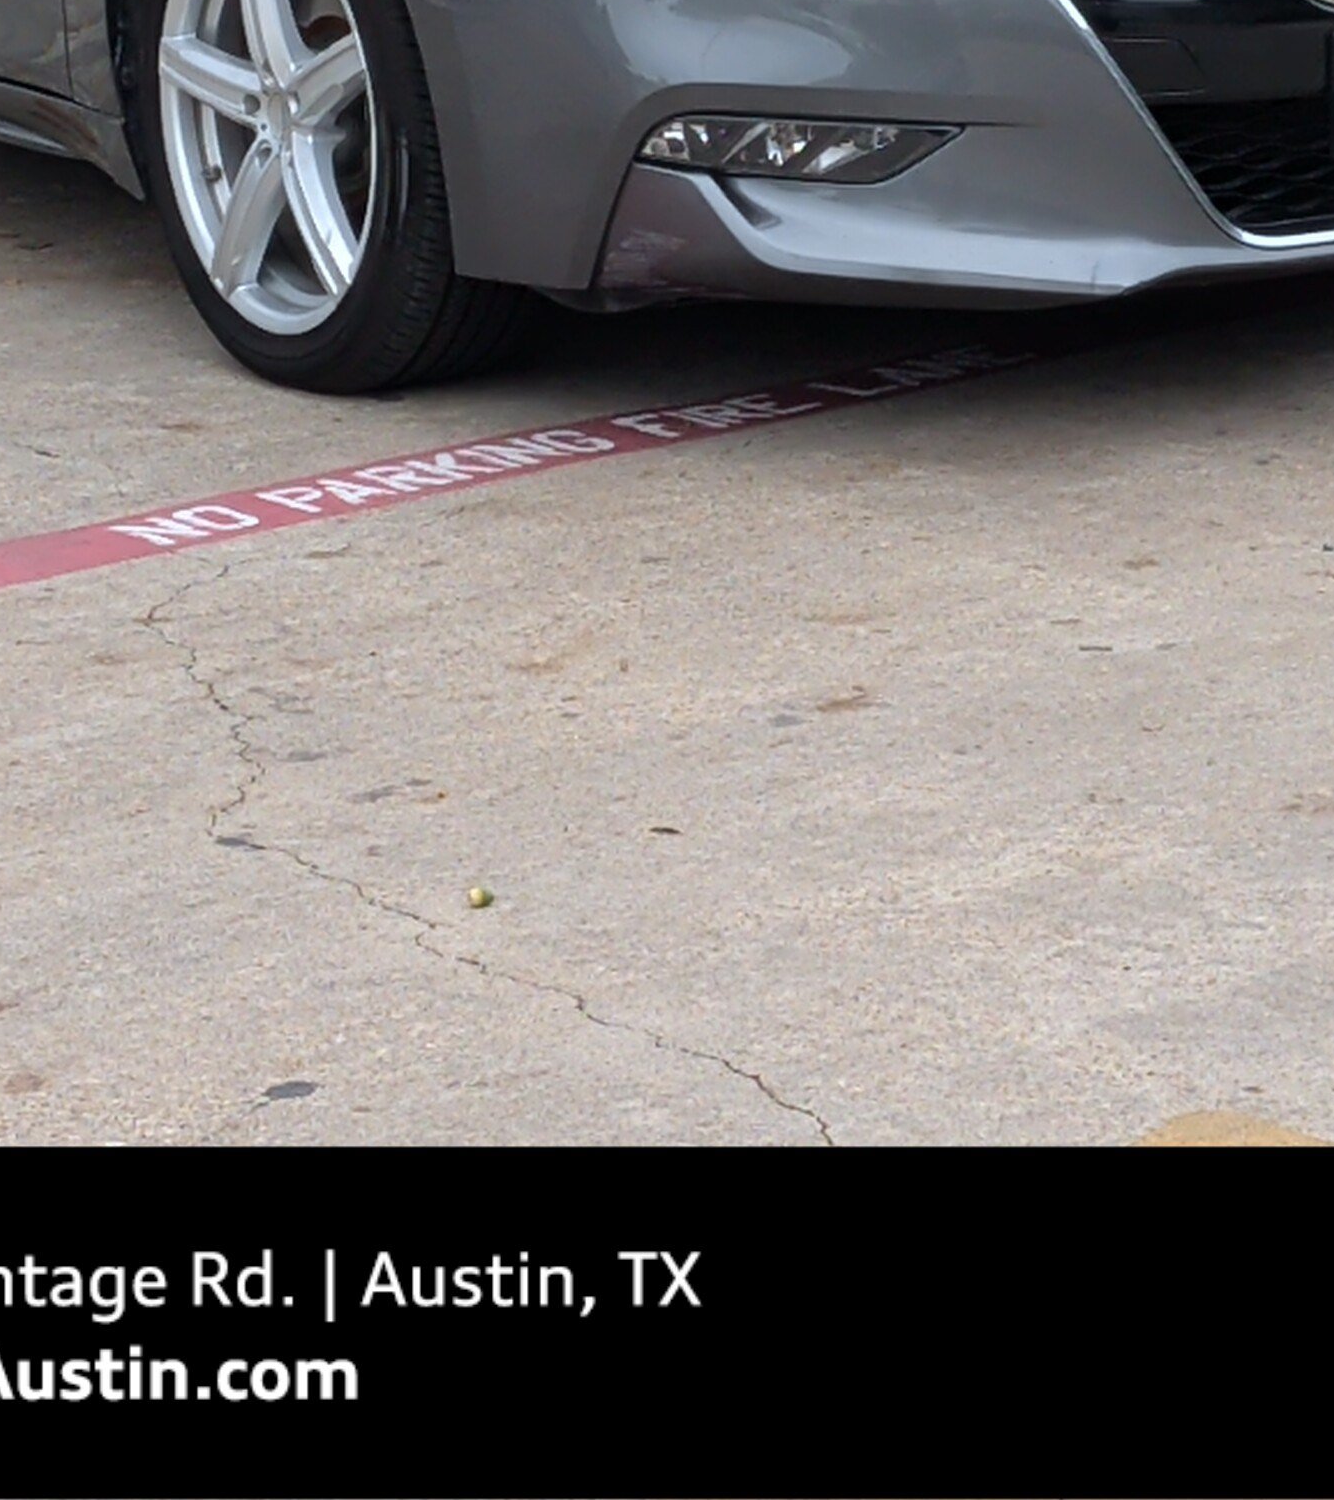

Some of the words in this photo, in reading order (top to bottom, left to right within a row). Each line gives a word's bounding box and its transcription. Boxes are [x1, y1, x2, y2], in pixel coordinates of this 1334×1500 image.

[107, 505, 259, 546] NO
[257, 429, 615, 515] PARKING
[611, 394, 823, 438] FIRE
